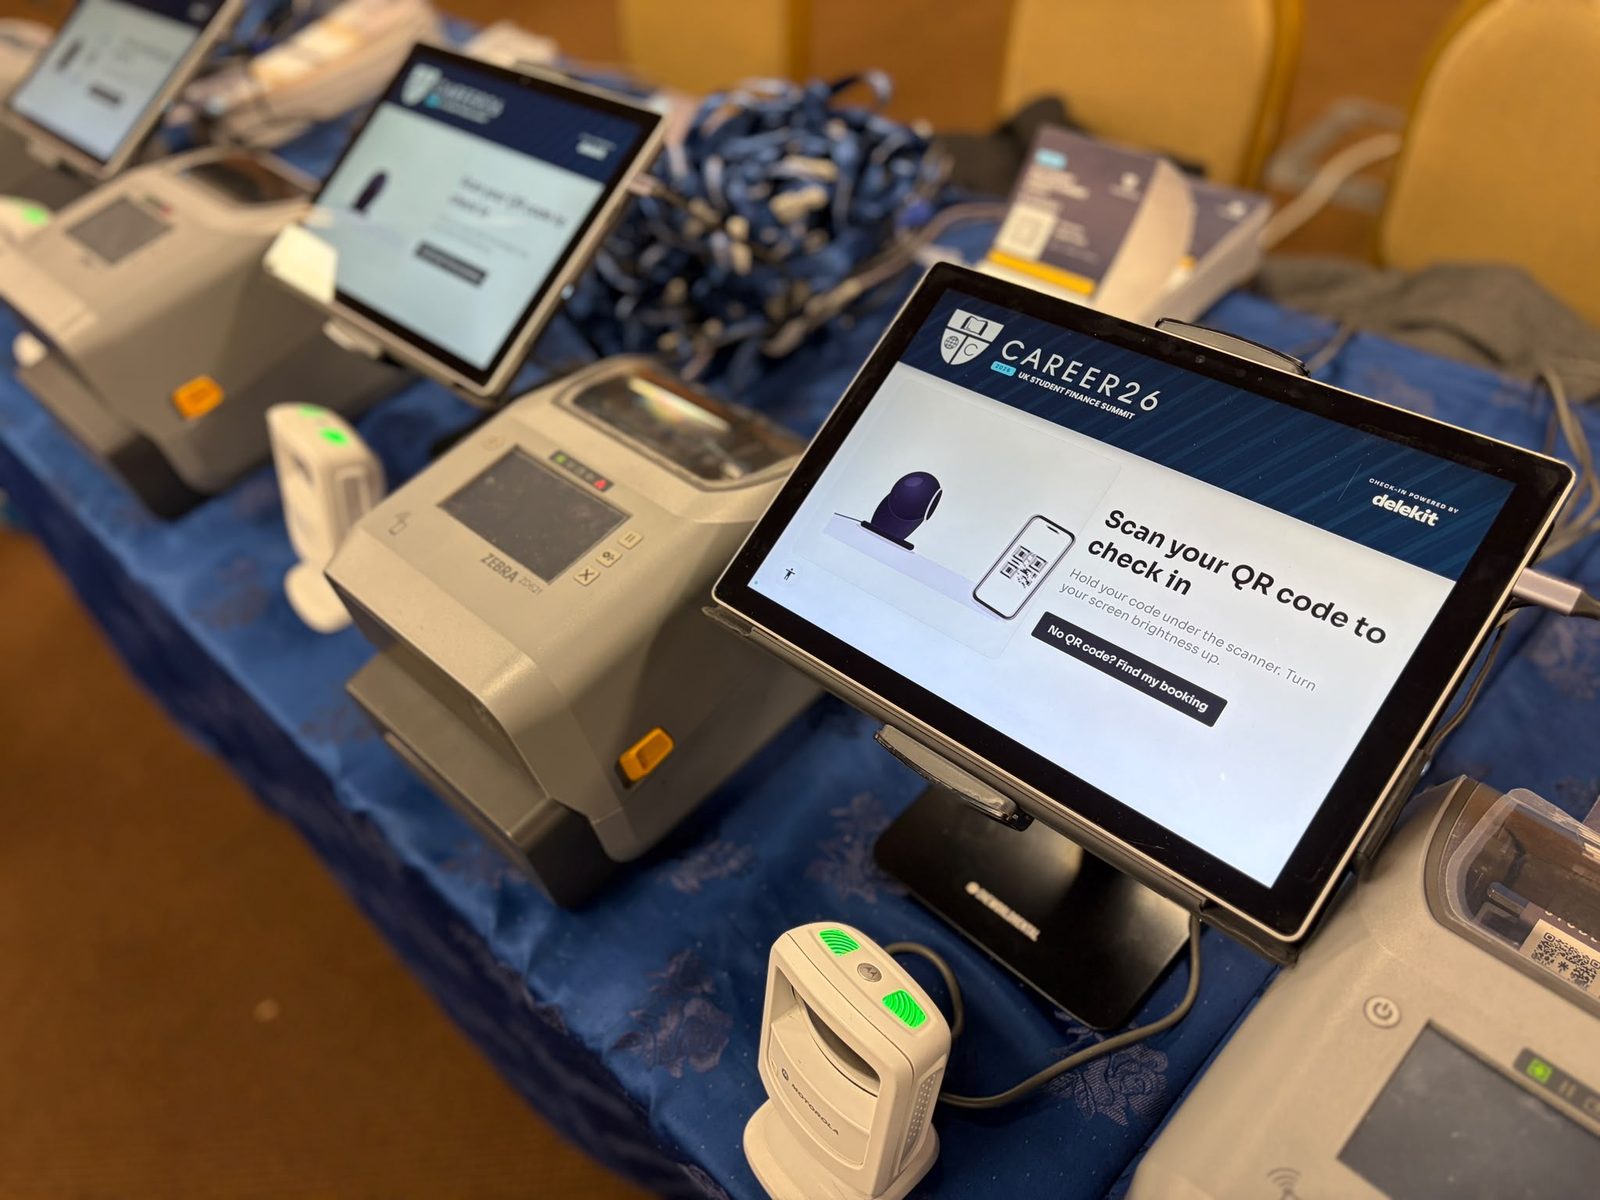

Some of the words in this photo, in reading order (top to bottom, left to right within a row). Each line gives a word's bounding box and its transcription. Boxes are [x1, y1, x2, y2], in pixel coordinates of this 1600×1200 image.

[1001, 340, 1161, 411] CAREER26
[1018, 371, 1031, 381] UK
[1030, 376, 1066, 394] STUDENT
[1064, 389, 1102, 408] FINANCE
[1100, 402, 1136, 420] SUMMIT
[1368, 478, 1408, 496] CHECK-IN
[1408, 492, 1447, 510] POWERED
[1447, 505, 1459, 514] BY
[1372, 494, 1439, 527] delekit
[481, 552, 519, 583] ZEBRA
[1087, 538, 1164, 584] check
[1165, 569, 1192, 596] in
[1104, 509, 1165, 548] Scan
[1164, 539, 1229, 575] your
[1230, 564, 1275, 596] QR
[1276, 585, 1349, 629] code
[1353, 615, 1387, 645] to
[1059, 583, 1089, 601] your
[1088, 596, 1130, 621] screen
[1130, 615, 1200, 655] brightness
[1200, 650, 1220, 666] up.
[1069, 568, 1101, 589] Hold
[1098, 584, 1129, 603] your
[1128, 597, 1161, 618] code
[1162, 612, 1202, 636] under
[1202, 630, 1225, 648] the
[1225, 643, 1281, 676] scanner.
[1285, 668, 1316, 692] Turn
[1047, 624, 1065, 639] No
[1065, 633, 1083, 649] QR
[1082, 643, 1117, 665] code?
[1116, 659, 1142, 678] Find
[1140, 673, 1160, 688] my
[1159, 680, 1209, 713] booking
[791, 1083, 839, 1135] MOTOROLA
